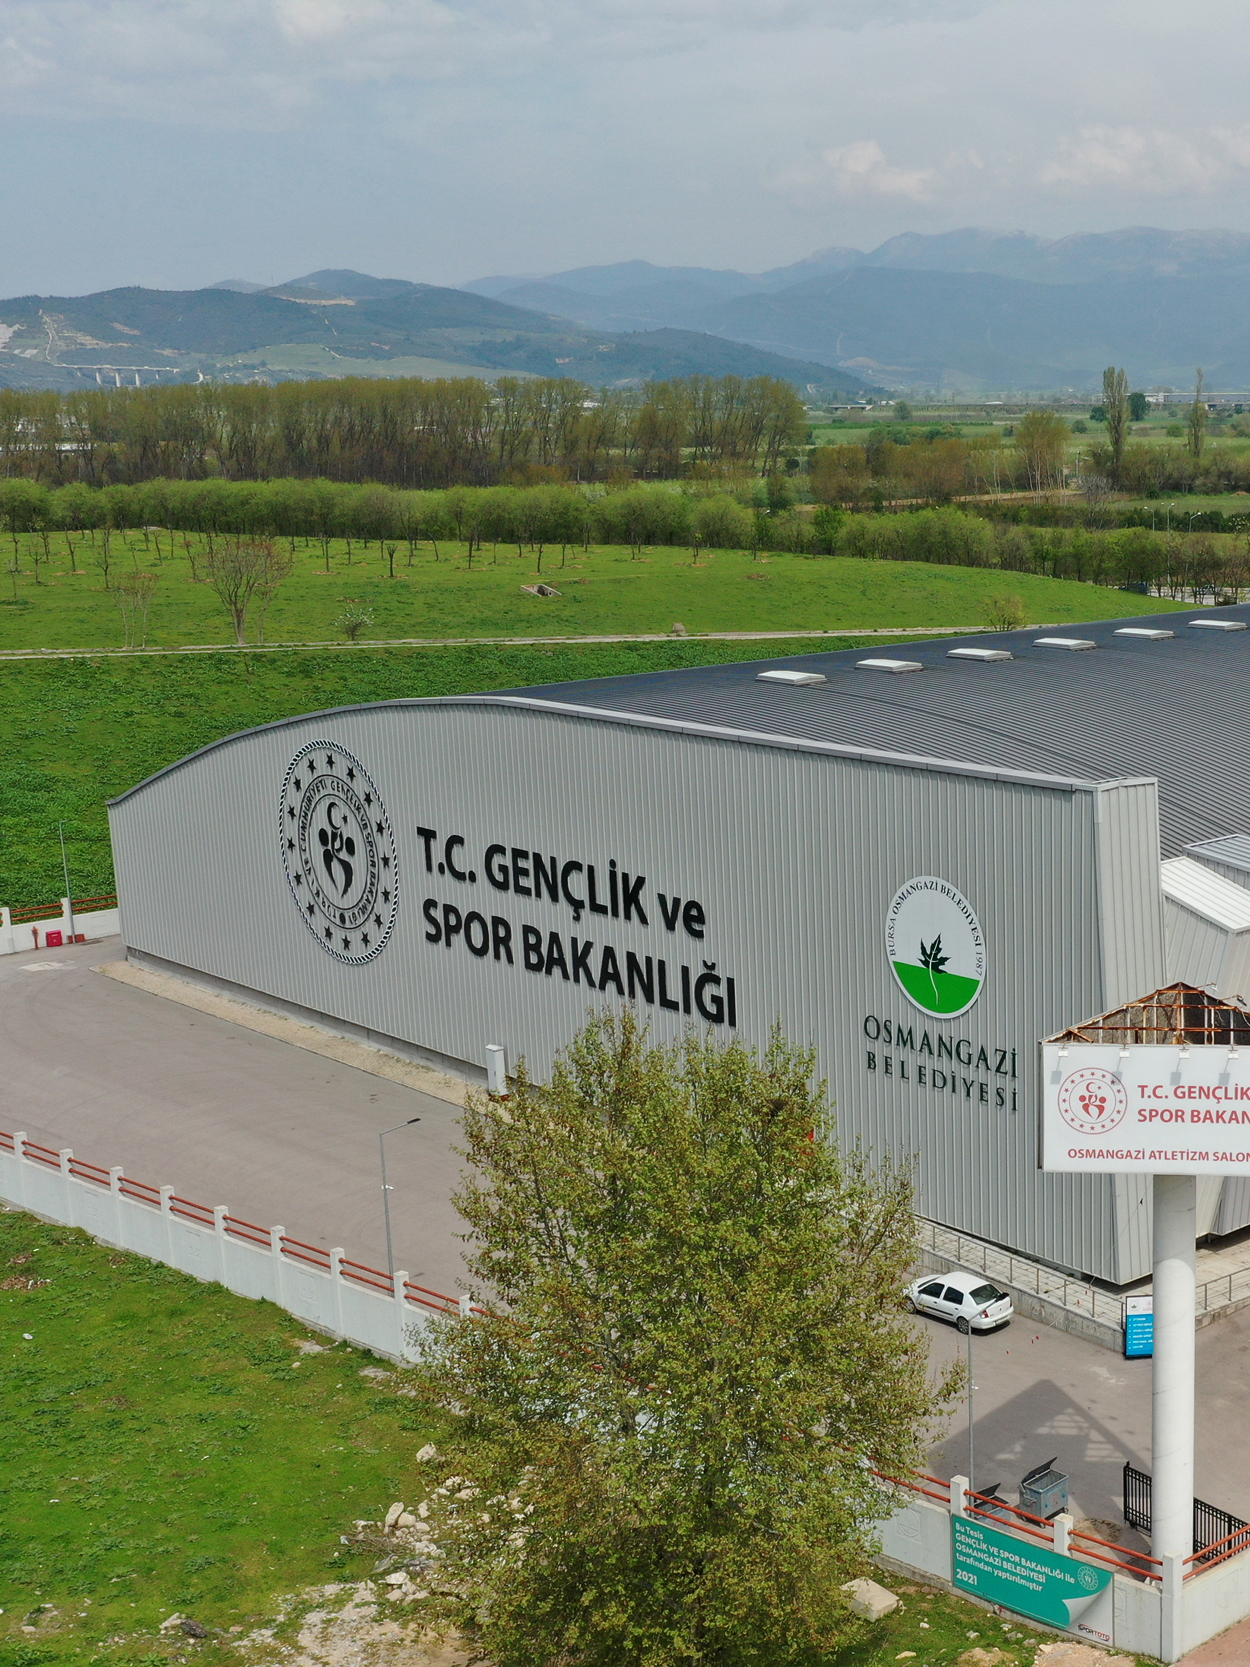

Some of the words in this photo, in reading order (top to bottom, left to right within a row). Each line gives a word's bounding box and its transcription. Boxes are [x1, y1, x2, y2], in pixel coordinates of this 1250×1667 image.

[367, 832, 377, 868] SPOR
[416, 825, 477, 884] T.C.
[484, 843, 650, 925] GENÇLİK
[657, 892, 706, 940] ve
[891, 880, 939, 915] OSMANGAZİ
[940, 884, 983, 947] BELEDİYESİ
[889, 916, 897, 957] BURSA
[422, 898, 514, 966] SPOR
[523, 923, 737, 1028] BAKANLIĞI
[975, 950, 984, 976] 1987
[863, 1015, 1018, 1079] OSMANGAZİ
[866, 1050, 1018, 1112] BELEDİYESİ
[1137, 1085, 1169, 1099] T.C.
[1173, 1083, 1250, 1104] GENÇLİK
[1137, 1108, 1186, 1124] SPOR
[1067, 1147, 1146, 1161] OSMANGAZİ
[1148, 1148, 1210, 1162] ATLETİZM
[955, 1522, 965, 1533] Bu
[966, 1526, 984, 1540] Tesis
[955, 1532, 988, 1551] GENÇLİK
[988, 1544, 999, 1556] VE
[999, 1548, 1020, 1563] SPOR
[1021, 1557, 1064, 1581] BAKANLIĞI
[1065, 1571, 1076, 1584] ile
[955, 1542, 1002, 1567] OSMANGAZİ
[1002, 1560, 1046, 1583] BELEDİYESİ
[956, 1552, 993, 1573] tarafından
[993, 1567, 1043, 1592] yaptırılmıştır
[956, 1568, 978, 1586] 2021
